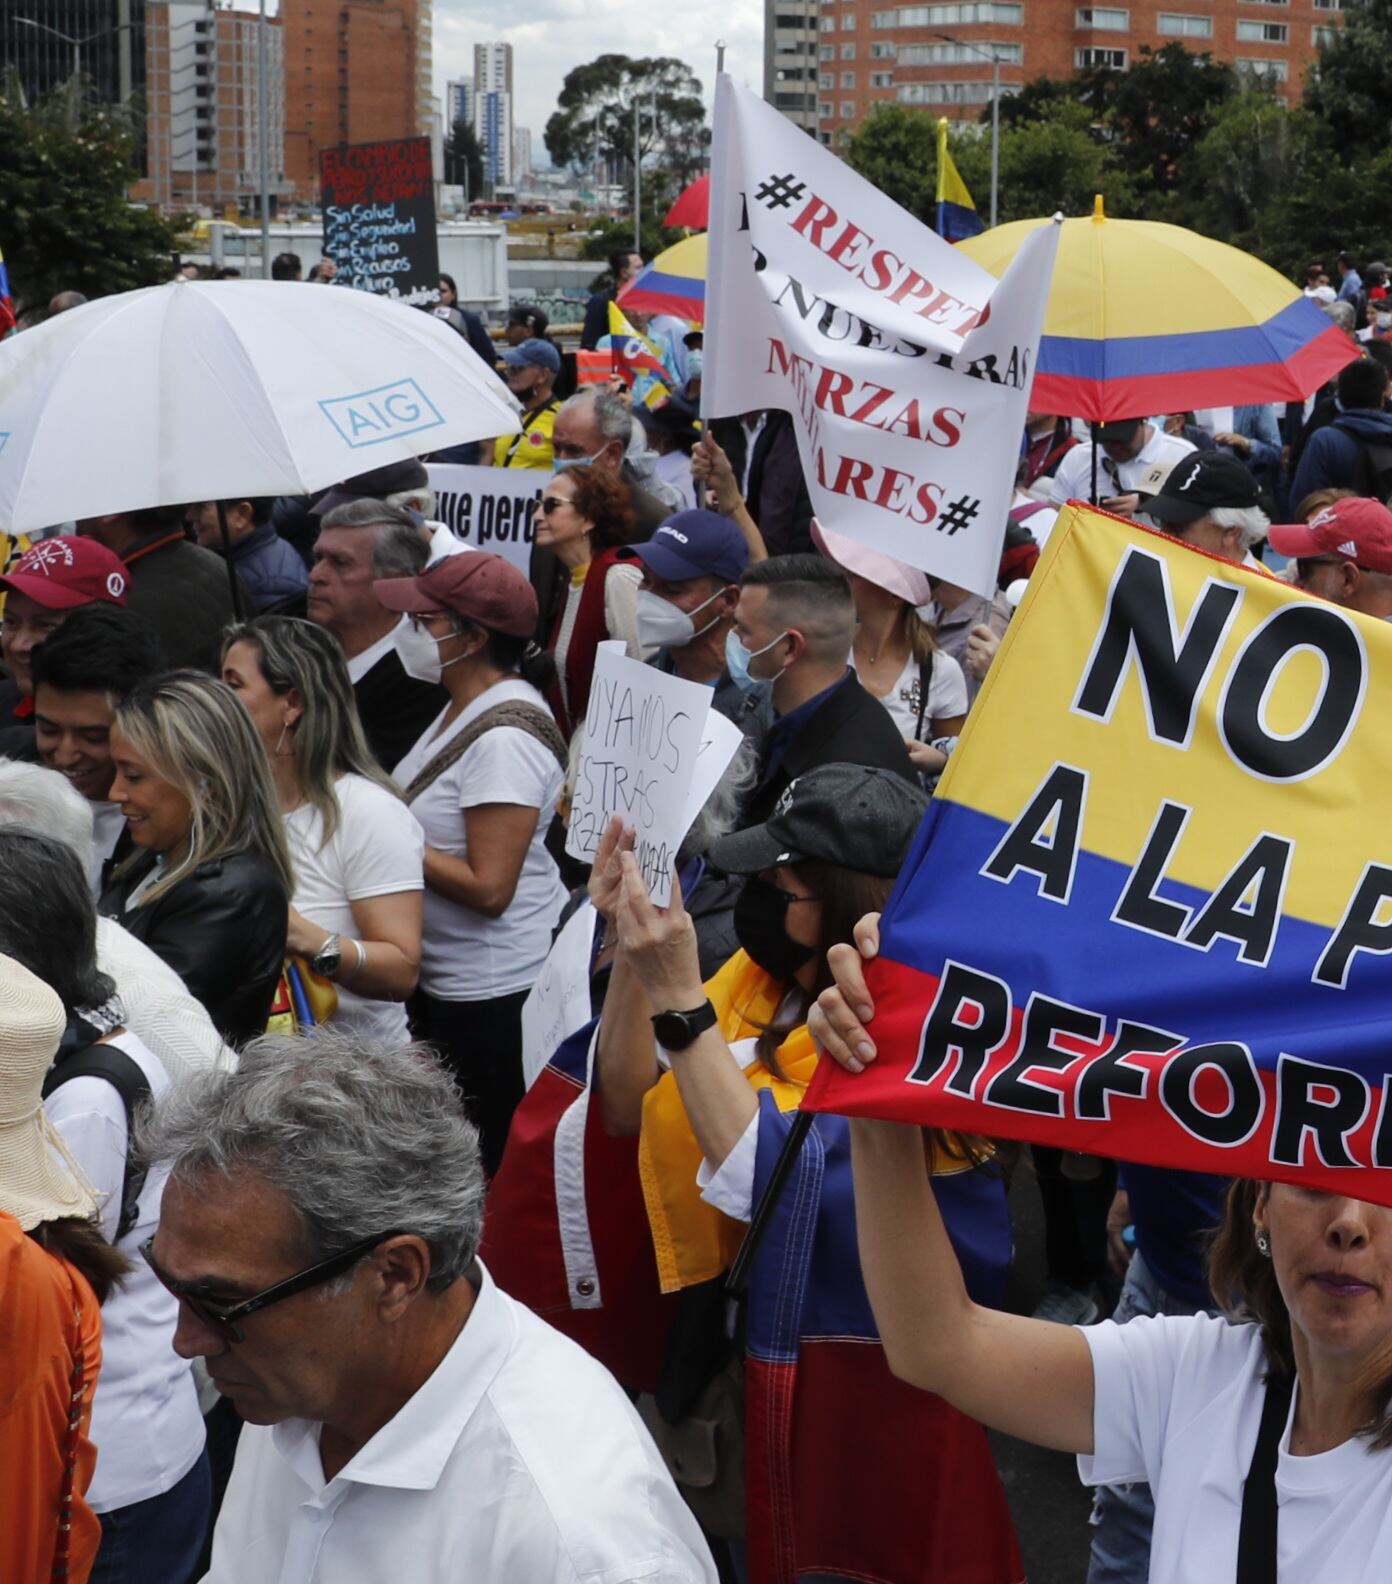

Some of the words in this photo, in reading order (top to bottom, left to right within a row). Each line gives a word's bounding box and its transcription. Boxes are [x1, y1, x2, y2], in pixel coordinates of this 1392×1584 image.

[326, 206, 351, 224] Sin
[351, 203, 395, 222] Salud
[350, 217, 416, 241] Seguridad
[326, 241, 350, 259] Sin
[350, 239, 399, 260] Empleo
[352, 257, 411, 275] Recursos
[347, 393, 421, 436] AIG
[1069, 542, 1370, 784] NO
[979, 761, 1090, 905] A
[1108, 798, 1297, 968] LA
